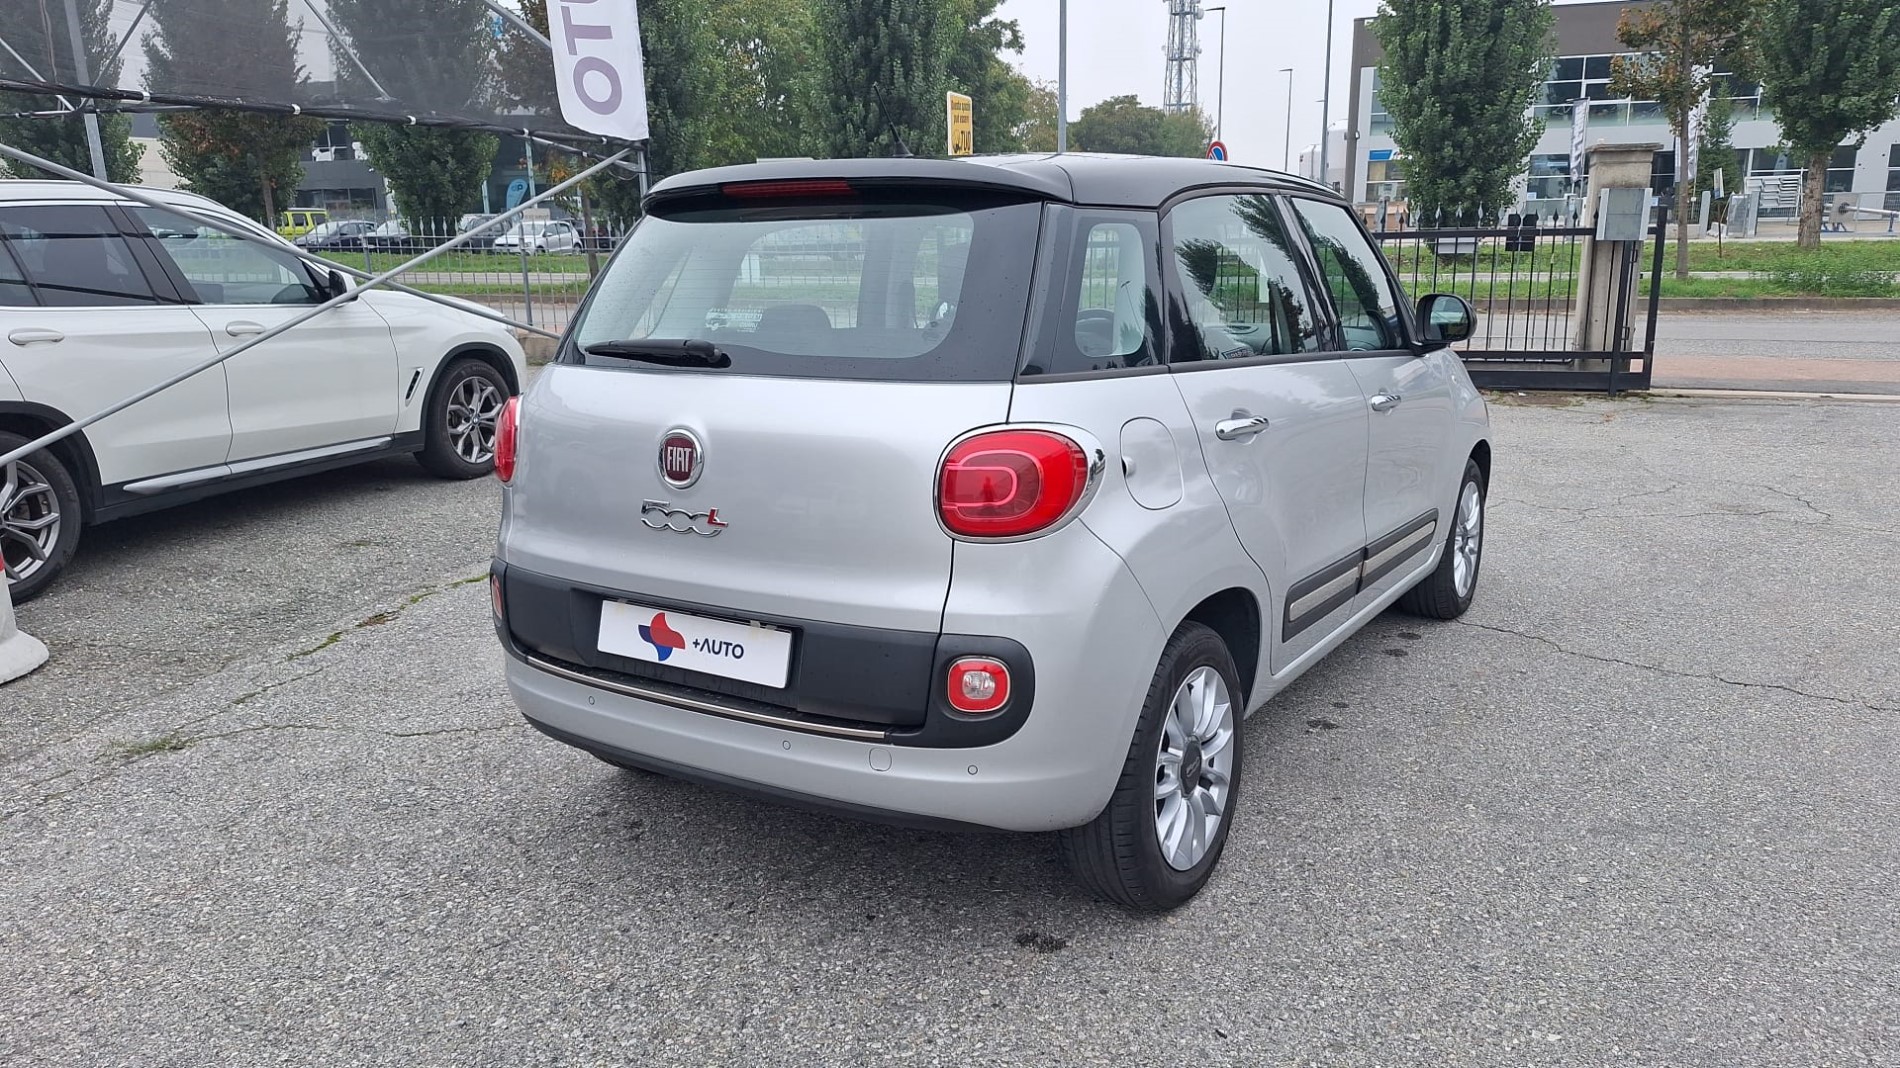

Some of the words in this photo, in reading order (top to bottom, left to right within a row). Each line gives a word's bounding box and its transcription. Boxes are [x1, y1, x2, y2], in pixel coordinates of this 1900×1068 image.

[559, 0, 623, 116] TO
[666, 446, 692, 473] FIAT
[641, 498, 729, 539] 500L
